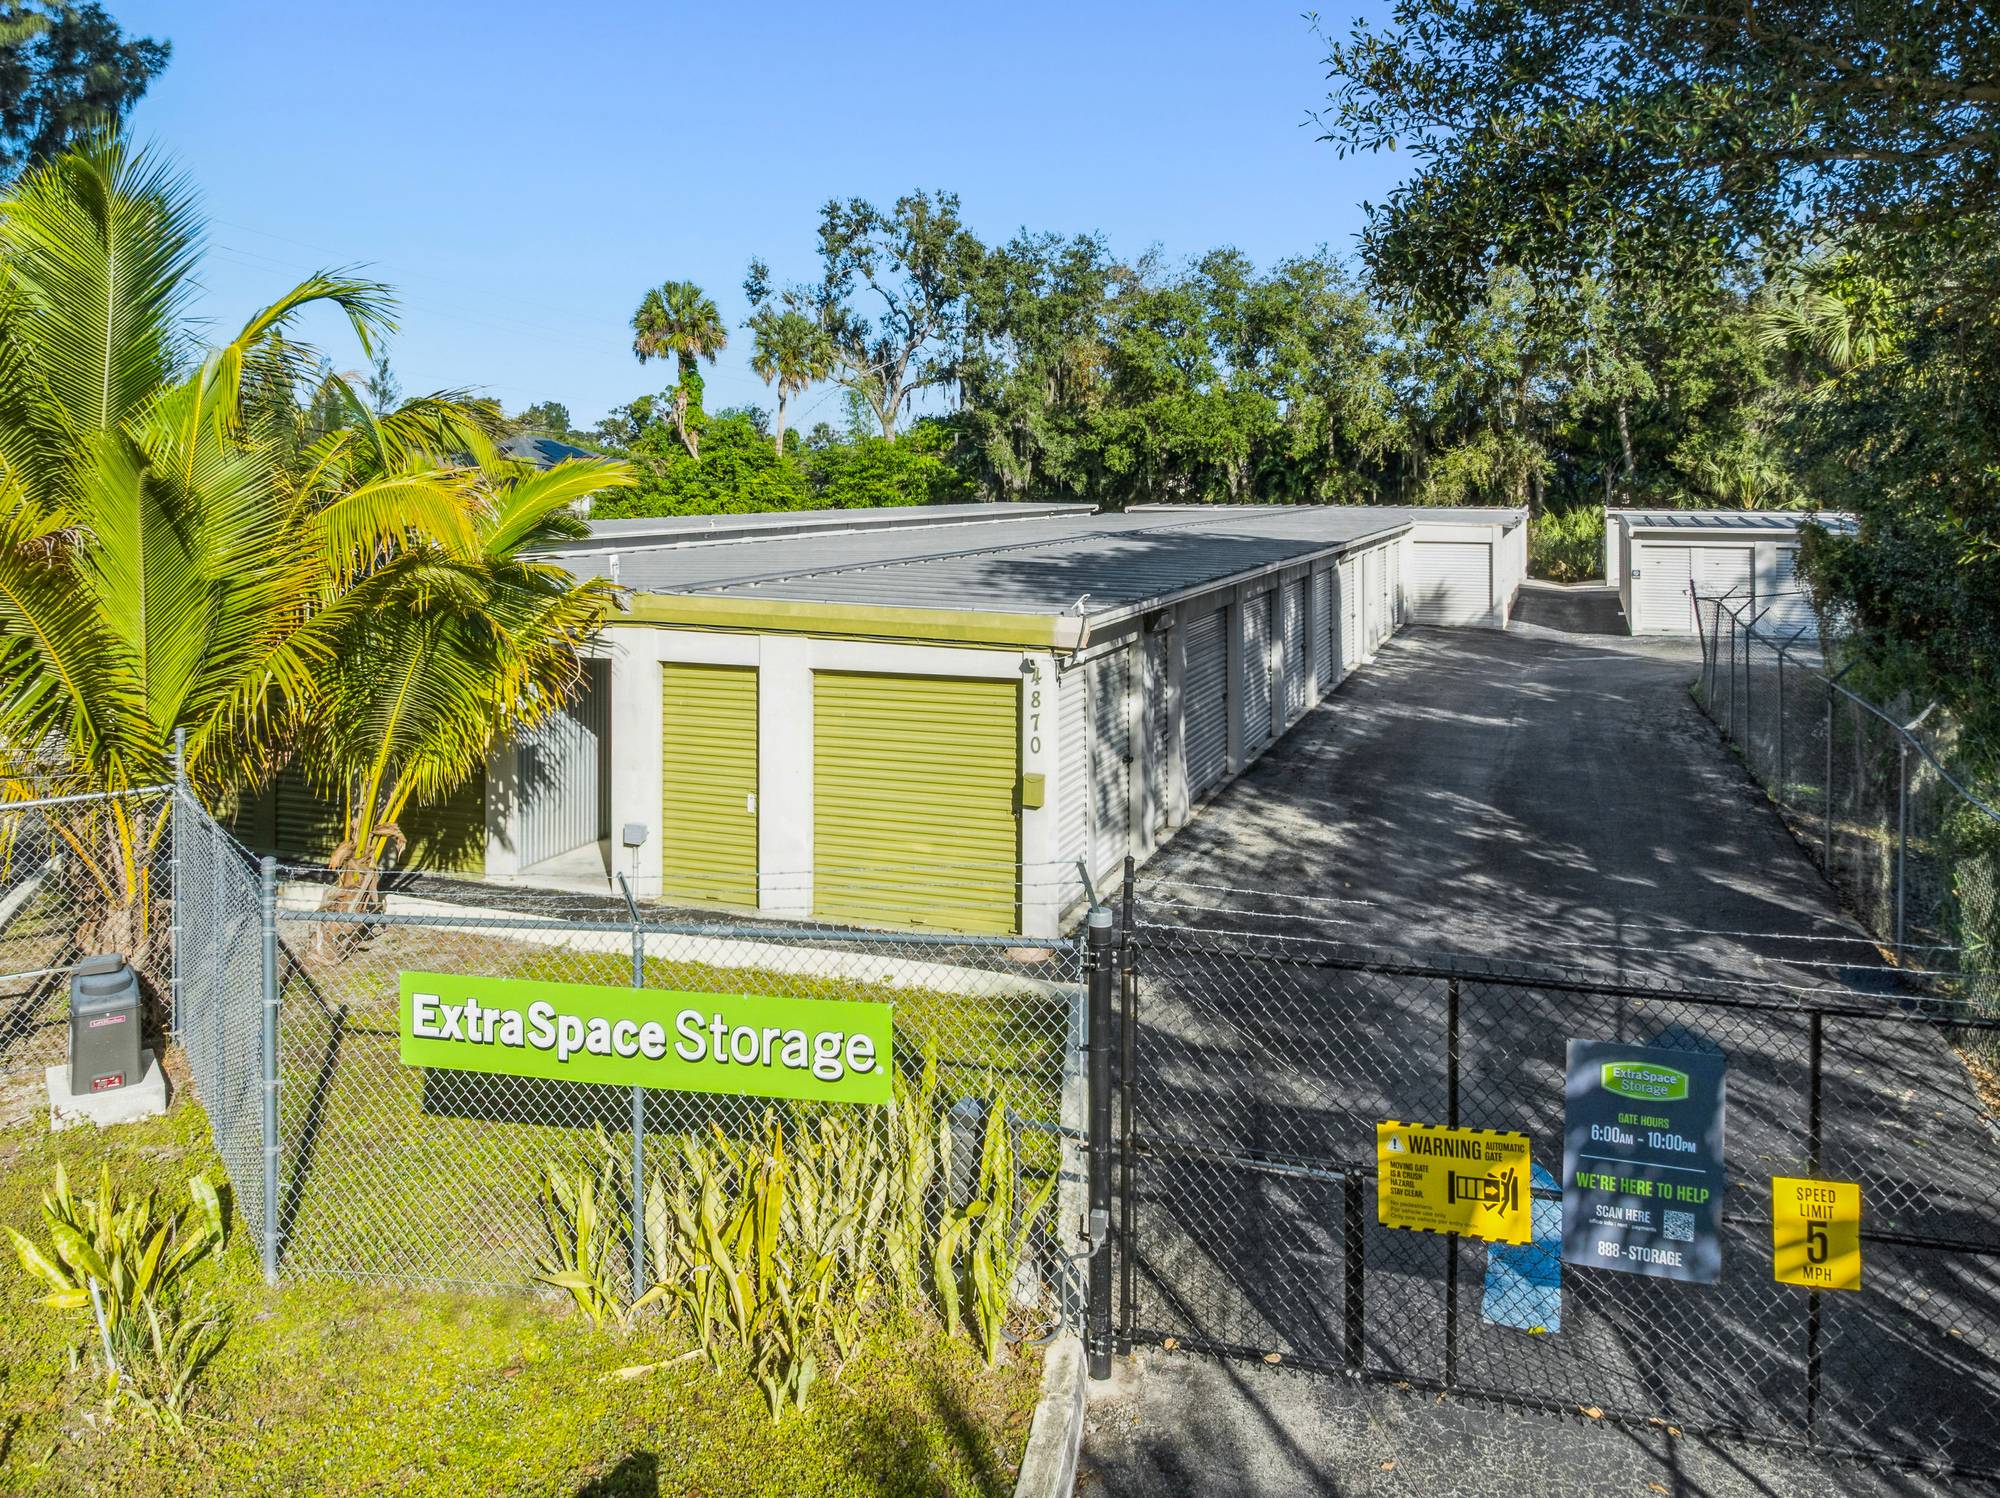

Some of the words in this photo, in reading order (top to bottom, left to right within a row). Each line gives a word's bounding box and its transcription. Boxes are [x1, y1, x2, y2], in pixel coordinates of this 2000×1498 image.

[1030, 667, 1041, 754] 4870
[412, 992, 666, 1063] ExtraSpace
[1613, 1067, 1677, 1084] ExtraSpace
[1622, 1080, 1668, 1096] Storage
[1618, 1112, 1639, 1125] GATE
[1640, 1115, 1670, 1129] HOURS
[1591, 1124, 1634, 1145] 6:00AM
[1648, 1131, 1696, 1153] 10:00PM
[1408, 1135, 1482, 1160] WARNING
[1485, 1141, 1525, 1153] AUTOMATIC
[1485, 1152, 1503, 1162] GATE
[1390, 1161, 1413, 1171] MOVING
[1414, 1164, 1429, 1173] GATE
[1390, 1170, 1396, 1178] IS
[1396, 1170, 1401, 1178] A
[1402, 1172, 1423, 1181] CRUSH
[1390, 1187, 1403, 1196] STAY
[1576, 1172, 1616, 1192] WE'RE
[1620, 1177, 1653, 1197] HERE
[1656, 1182, 1672, 1199] TO
[1676, 1185, 1709, 1204] HELP
[1796, 1187, 1836, 1203] SPEED
[1596, 1204, 1622, 1219] SCAN
[1625, 1209, 1651, 1224] HERE
[1800, 1203, 1834, 1219] LIMIT
[1807, 1220, 1828, 1264] 5
[1803, 1265, 1832, 1281] MPH
